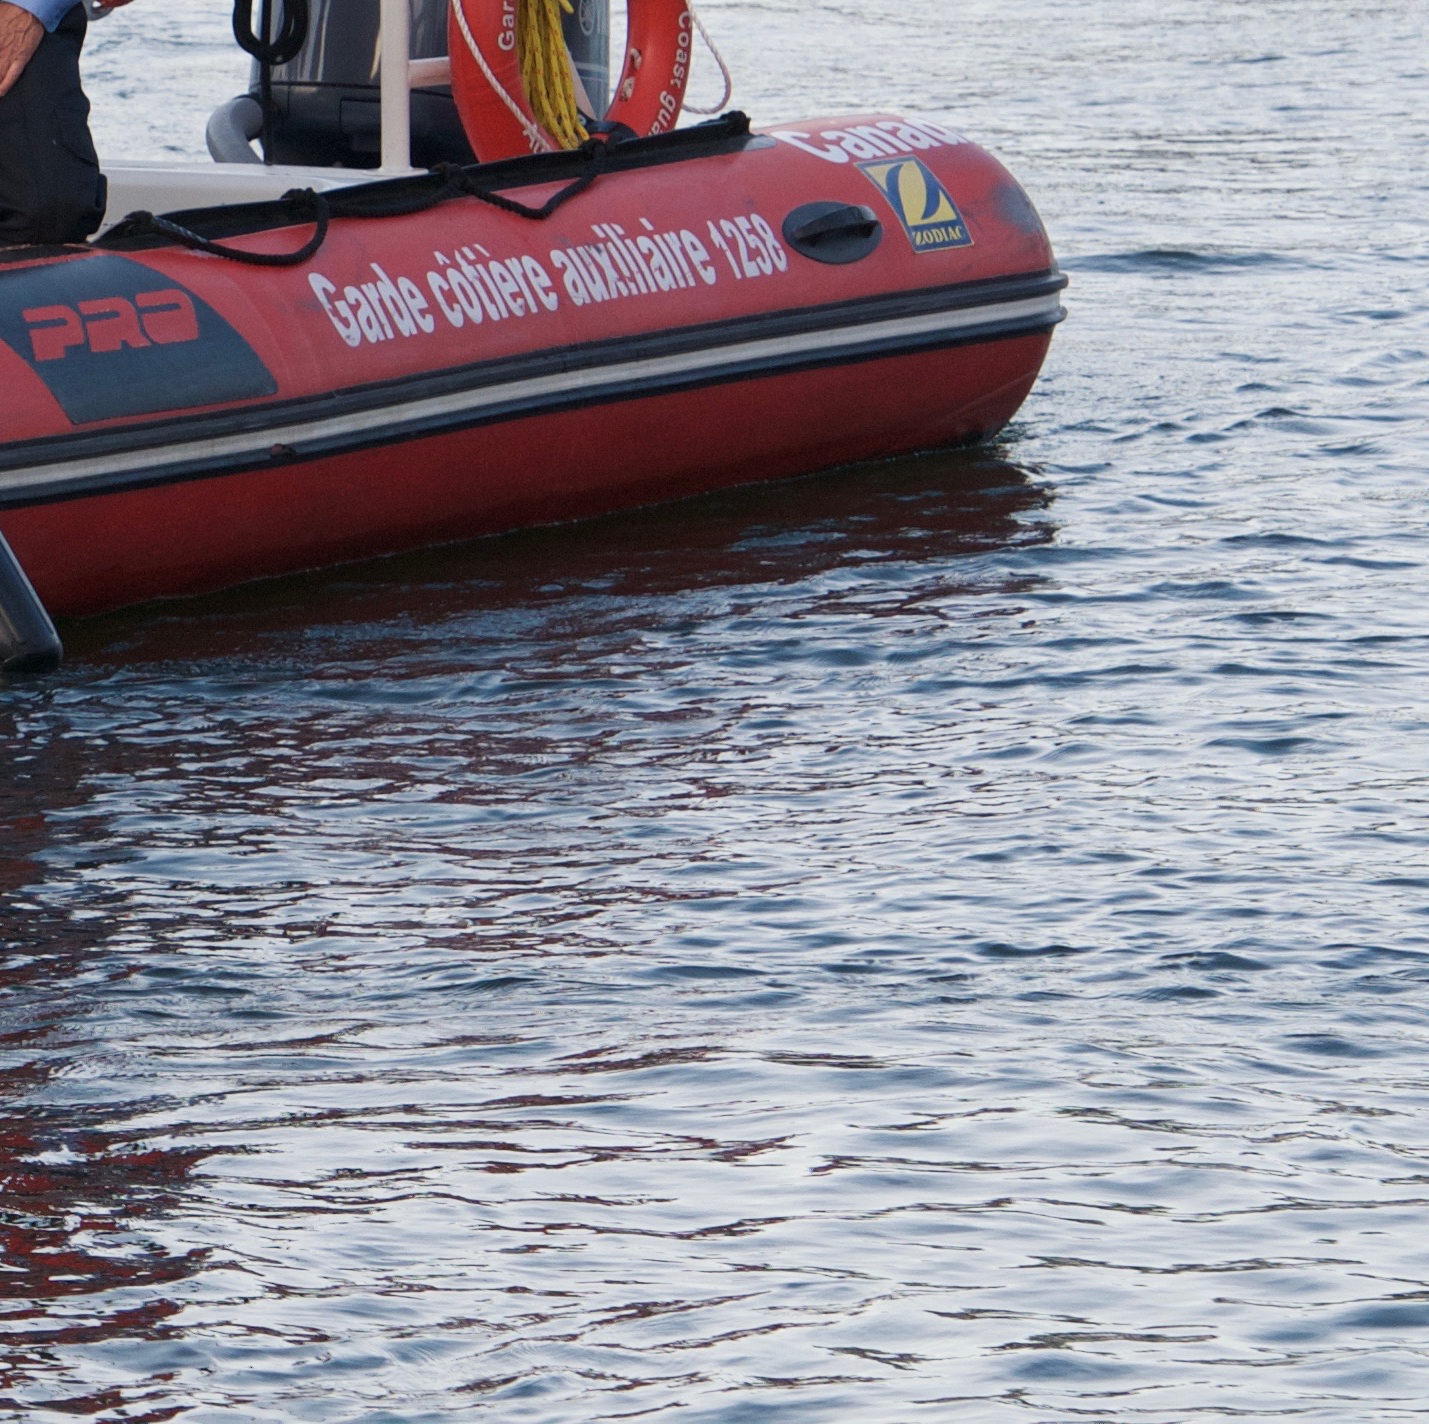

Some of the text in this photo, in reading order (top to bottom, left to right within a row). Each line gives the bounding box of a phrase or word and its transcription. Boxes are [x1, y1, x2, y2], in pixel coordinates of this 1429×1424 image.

[647, 10, 693, 136] Coast gua
[770, 117, 970, 164] Canad
[912, 225, 964, 246] ZODIAC
[307, 212, 788, 348] Garde côtière auxiliaire 1258
[21, 288, 199, 363] PRO
